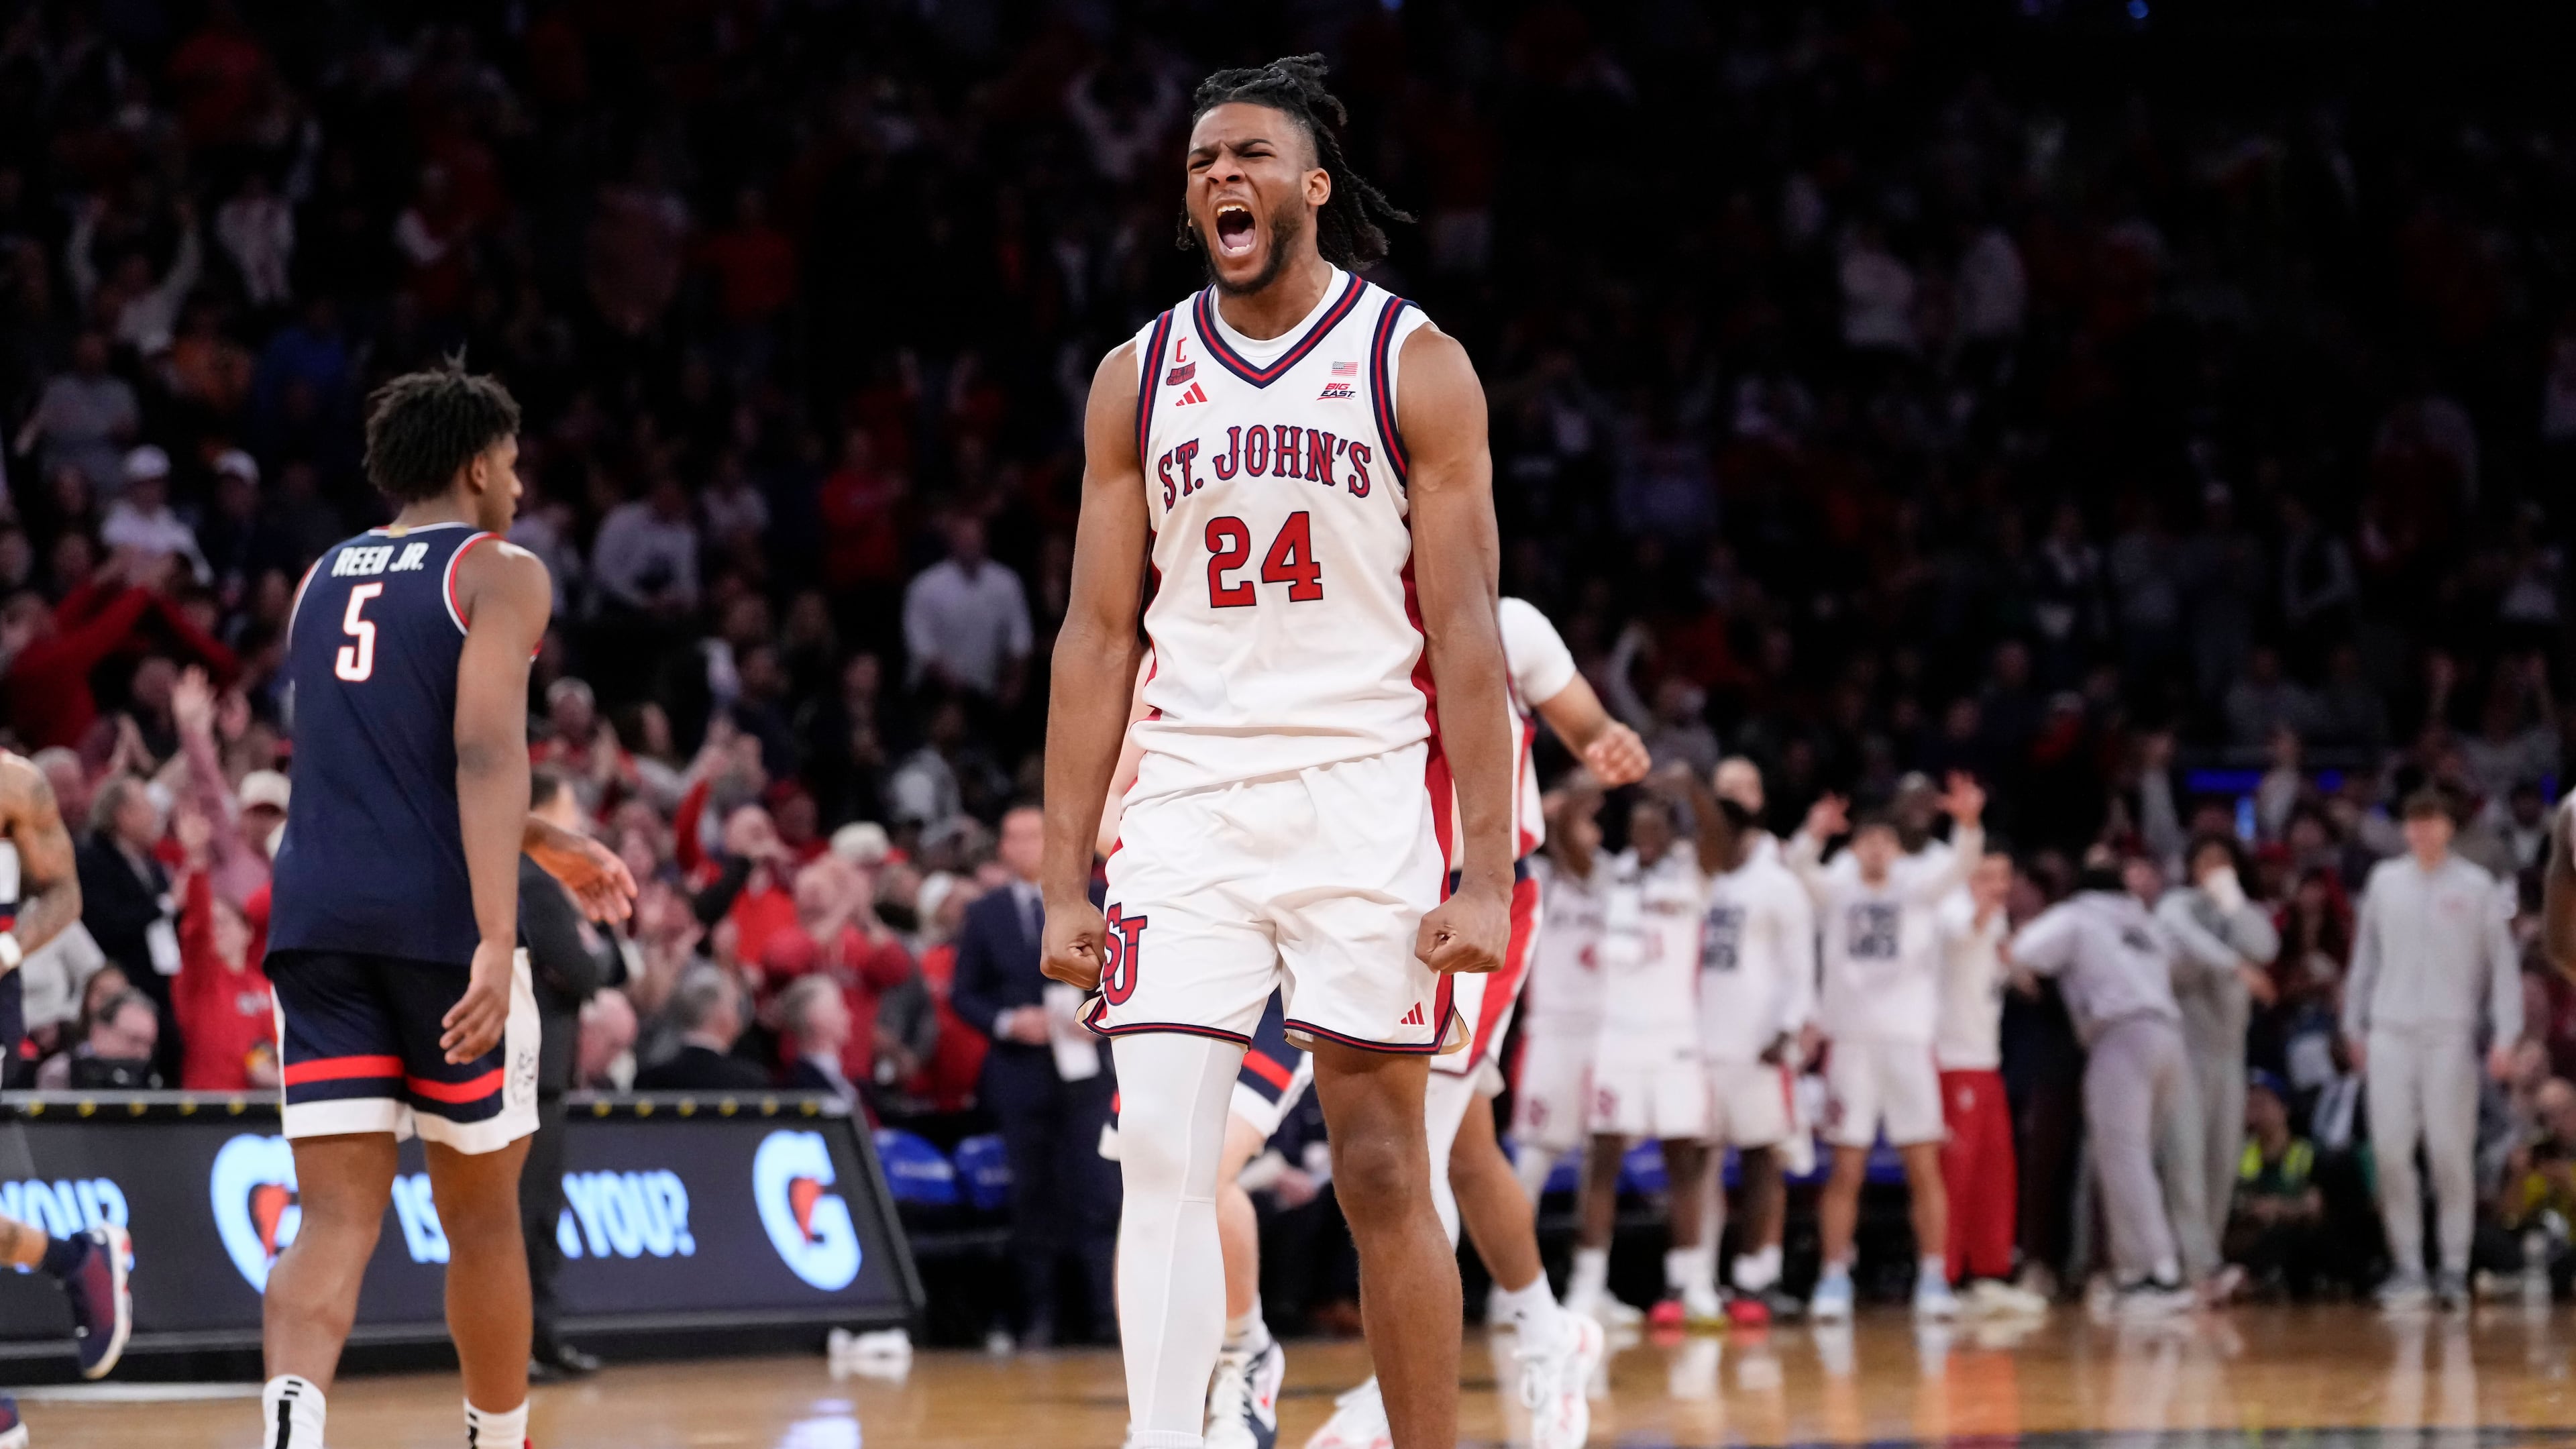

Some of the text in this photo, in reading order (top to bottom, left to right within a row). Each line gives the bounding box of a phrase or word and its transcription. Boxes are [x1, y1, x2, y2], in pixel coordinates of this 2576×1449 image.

[1176, 337, 1187, 362] C
[1159, 425, 1371, 514] ST. JOHN'S
[331, 542, 429, 577] REED JR.
[1205, 511, 1323, 608] 24
[335, 582, 384, 682] 5
[561, 1169, 696, 1259] YOU?
[753, 1129, 863, 1292] G
